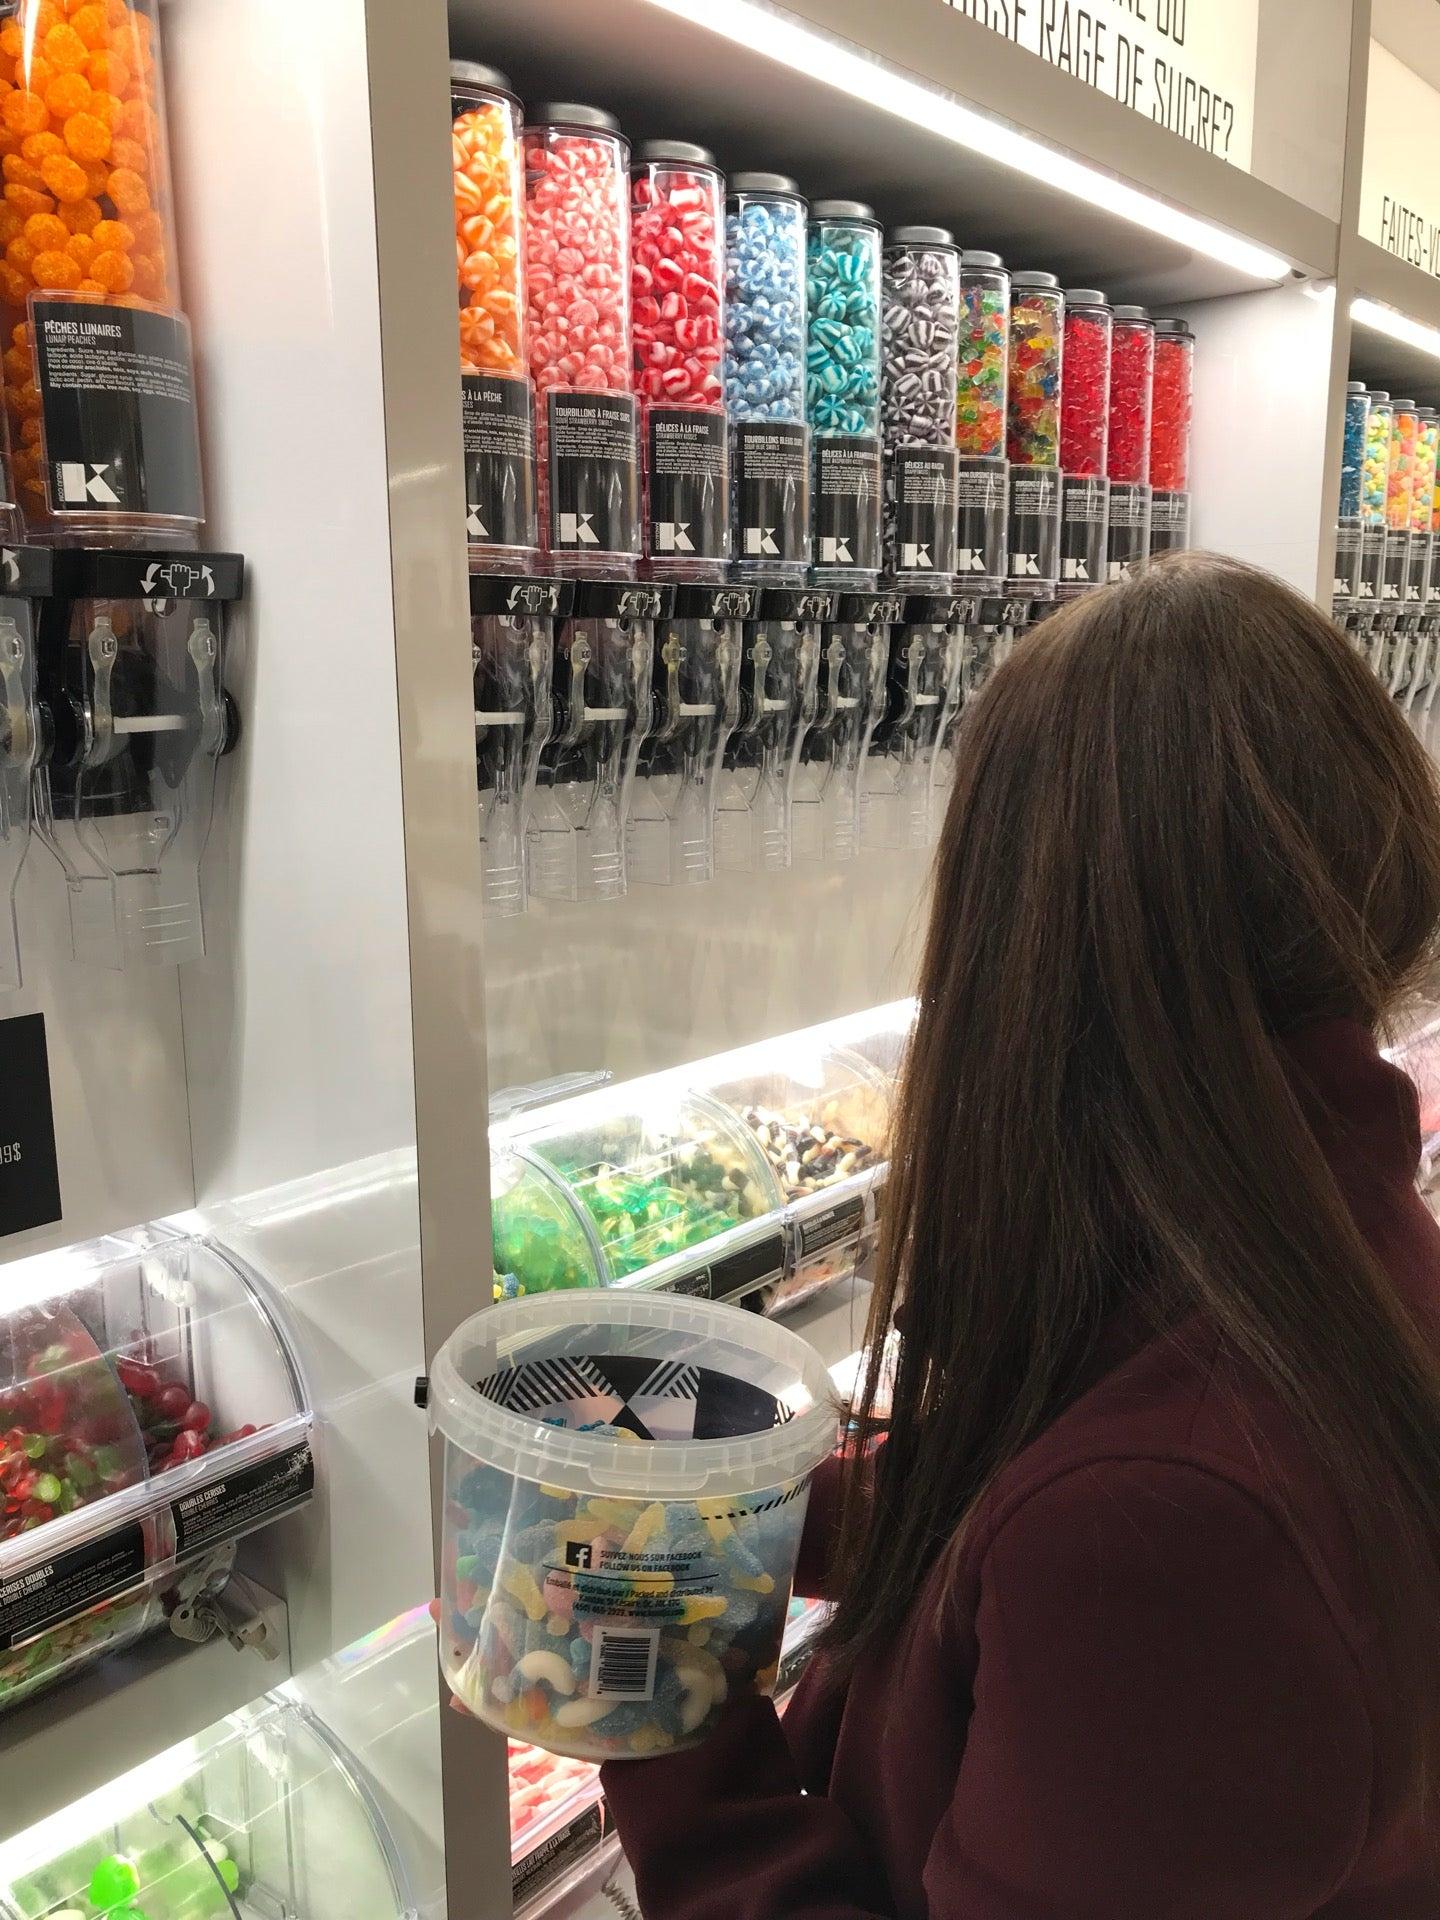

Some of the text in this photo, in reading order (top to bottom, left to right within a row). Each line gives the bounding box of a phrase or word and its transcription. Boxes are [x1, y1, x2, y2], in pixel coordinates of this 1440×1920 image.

[45, 320, 122, 338] PÊCHES LUNAIRES
[46, 334, 96, 345] LUNAR PEACHES
[467, 389, 472, 400] À
[474, 390, 482, 400] LA
[483, 390, 502, 403] PÊCHE
[556, 408, 596, 418] TOURBILLONS
[597, 408, 601, 418] À
[602, 410, 620, 420] FRAISE
[656, 422, 709, 434] DÉLICES À LA FRAISE
[666, 1551, 702, 1561] FACEBOOK
[600, 1561, 629, 1571] FOLLOW
[654, 1564, 690, 1572] FACEBOOK
[25, 1566, 54, 1586] DOUBLES
[24, 1579, 47, 1596] CHERRIES
